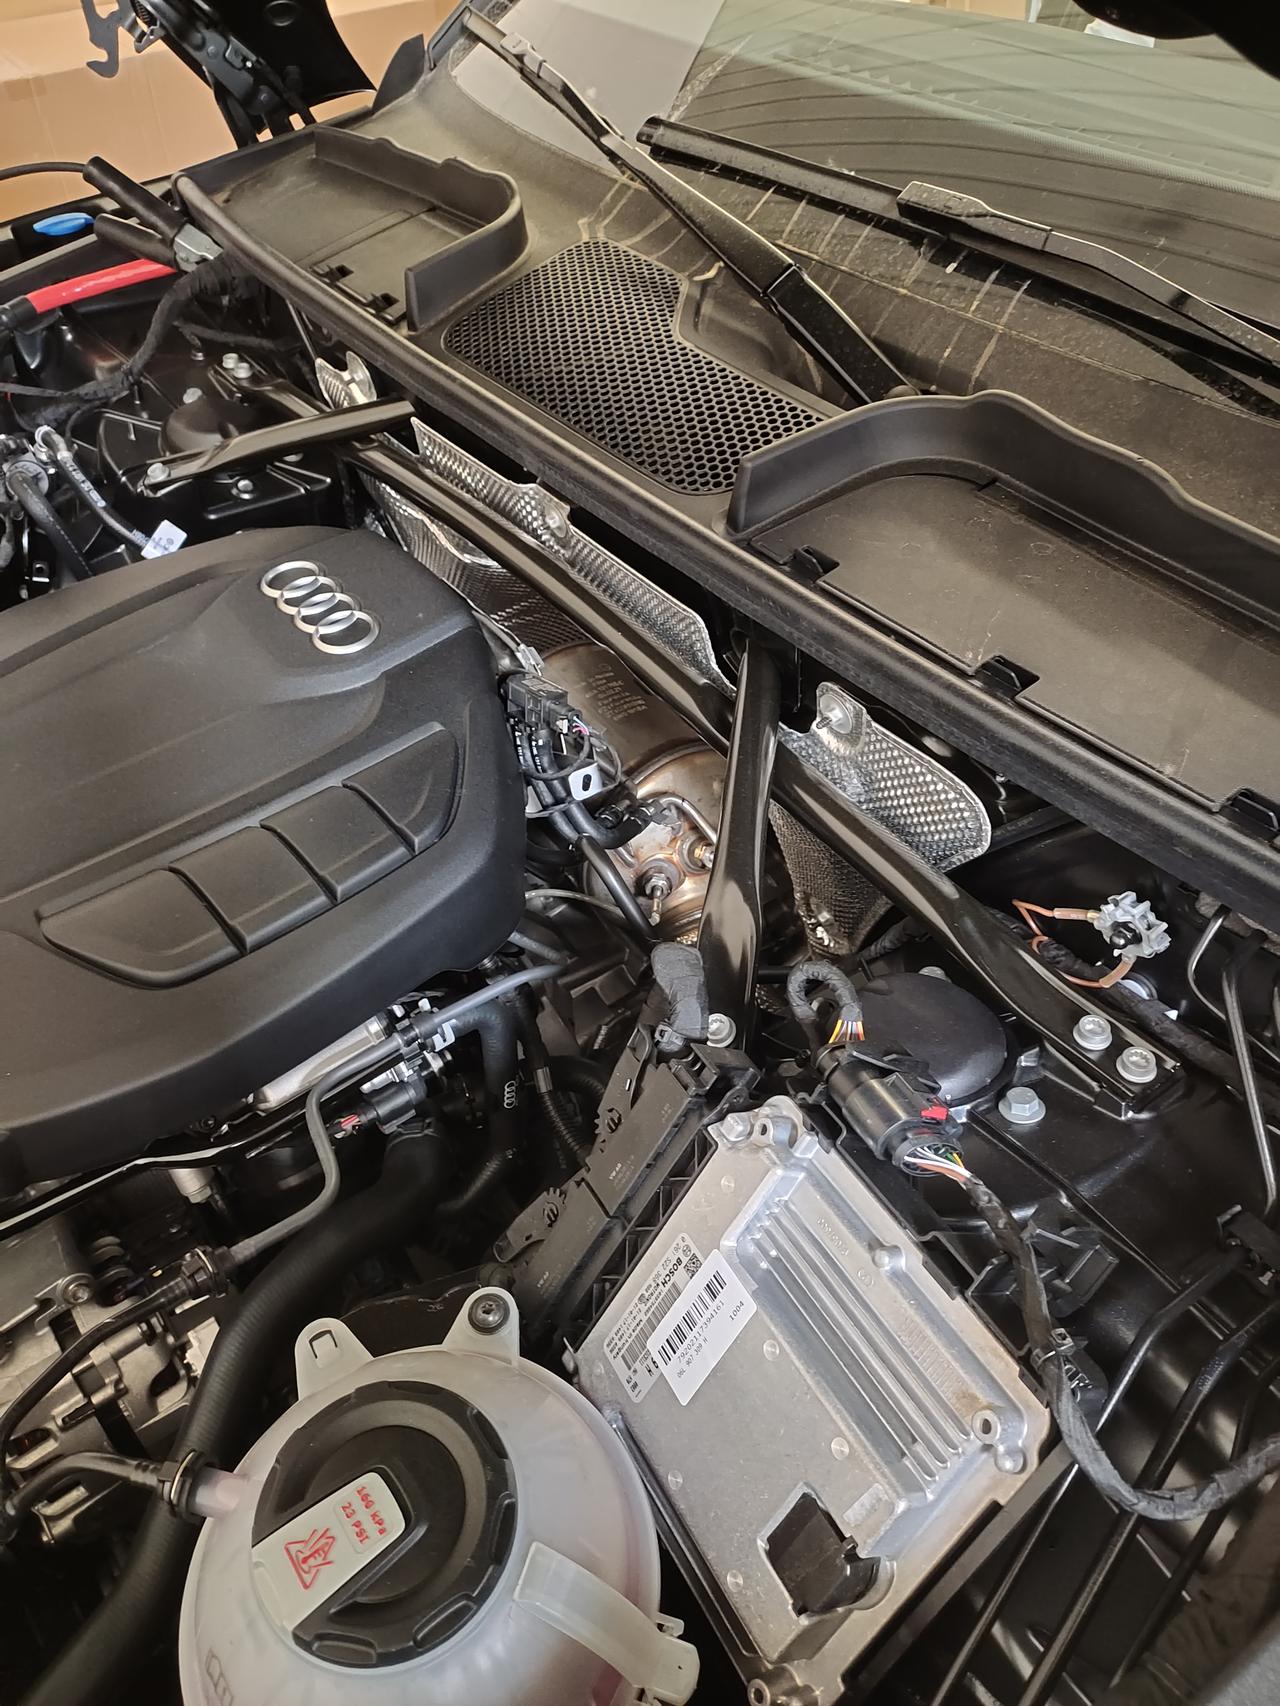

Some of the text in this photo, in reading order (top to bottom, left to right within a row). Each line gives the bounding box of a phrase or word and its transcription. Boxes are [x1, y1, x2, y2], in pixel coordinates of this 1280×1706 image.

[660, 1256, 682, 1288] BOSCH
[728, 1299, 744, 1321] 1004
[685, 1354, 694, 1367] 907
[702, 1336, 708, 1344] H
[341, 1502, 369, 1543] 23 PSI
